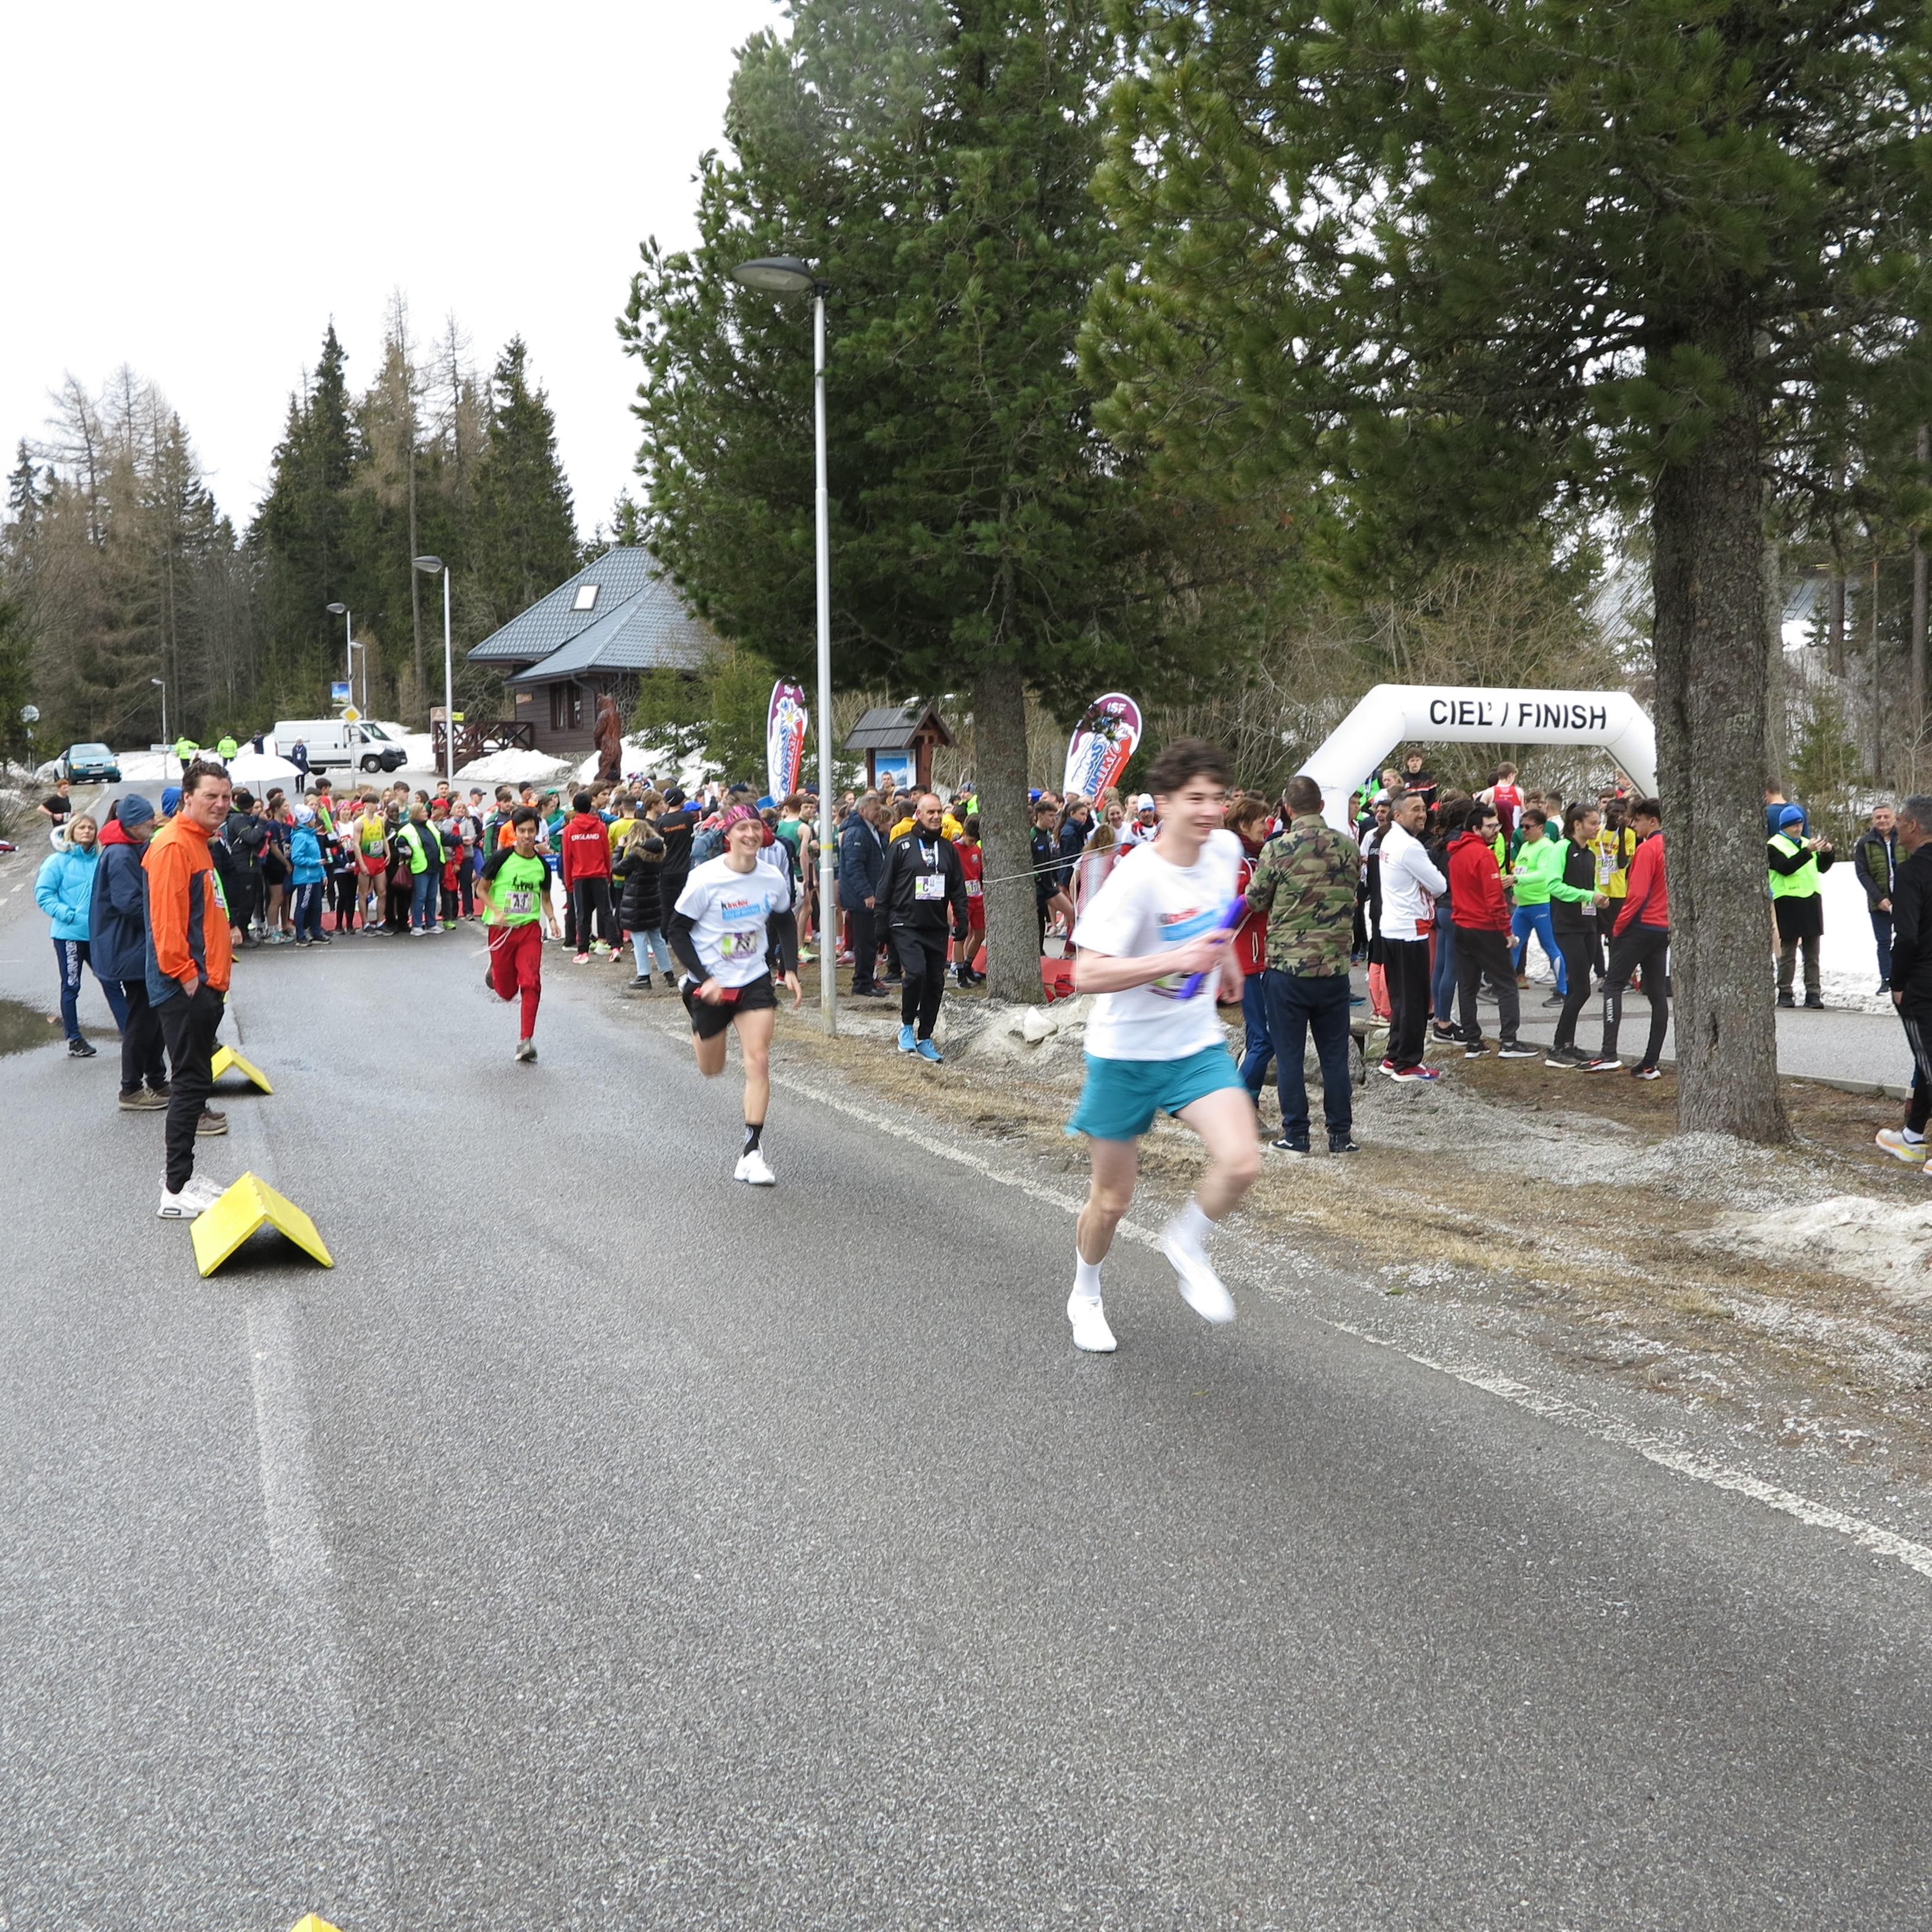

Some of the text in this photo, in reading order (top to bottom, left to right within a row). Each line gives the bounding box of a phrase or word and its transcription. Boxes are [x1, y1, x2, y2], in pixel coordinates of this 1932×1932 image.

[1107, 701, 1127, 714] ISF
[1500, 702, 1509, 727] /
[1518, 703, 1606, 730] FINISH
[571, 833, 600, 841] ENGLAND
